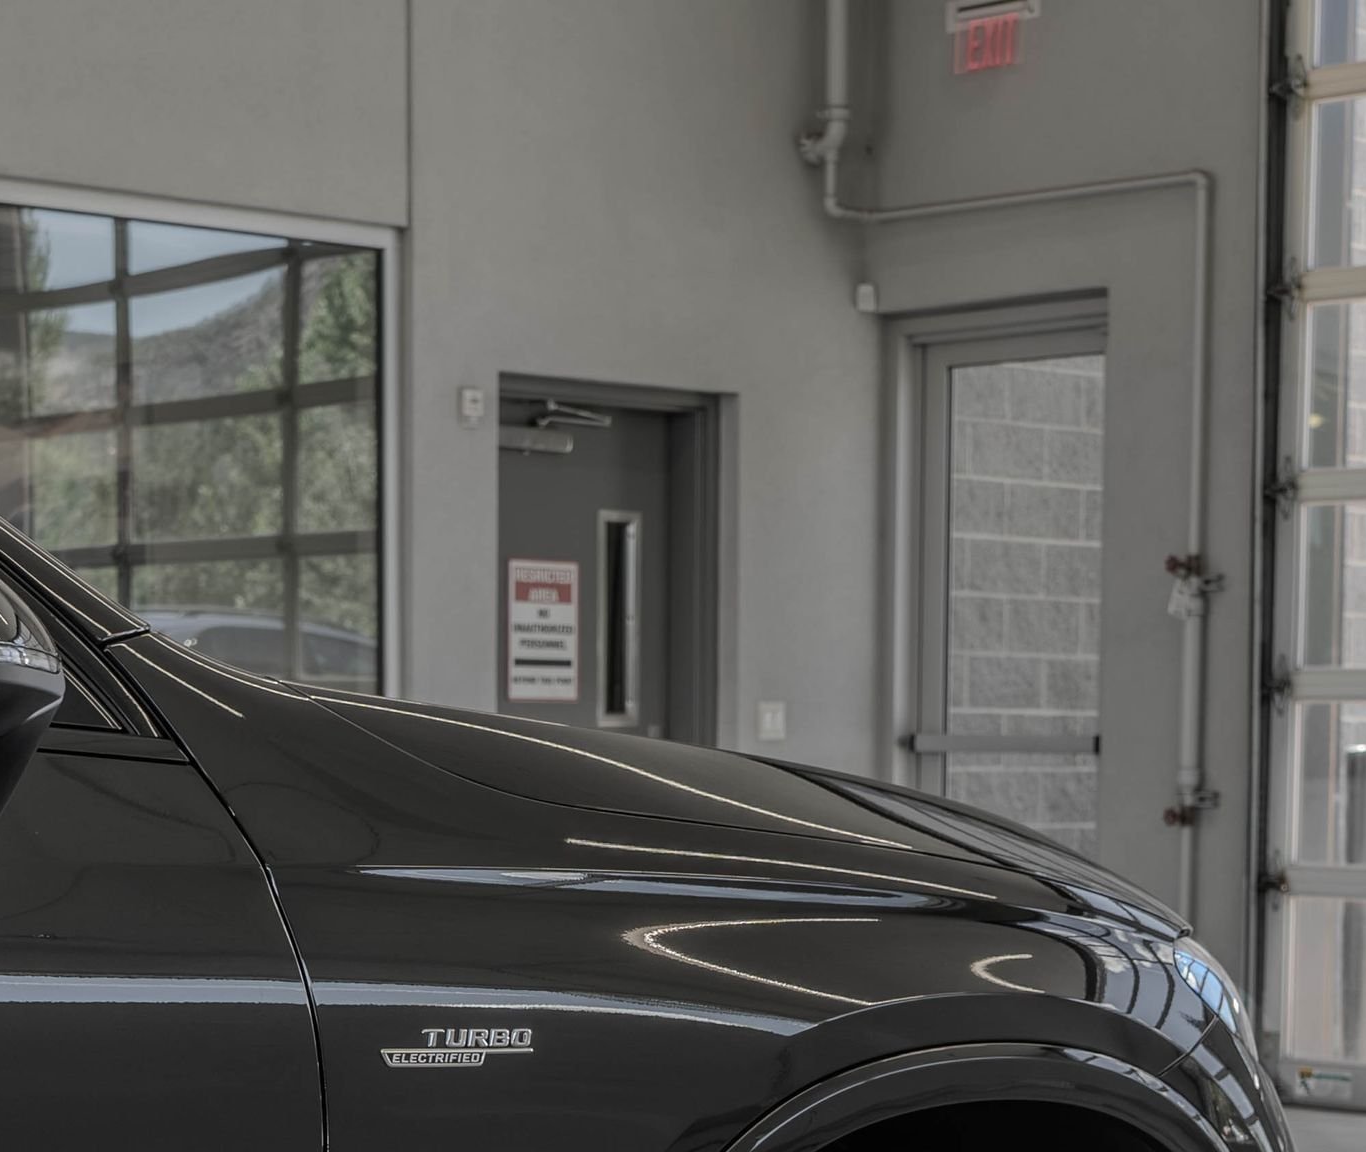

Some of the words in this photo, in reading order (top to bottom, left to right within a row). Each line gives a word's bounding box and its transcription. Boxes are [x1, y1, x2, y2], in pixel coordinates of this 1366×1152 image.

[967, 12, 1019, 71] EXIT
[421, 1028, 533, 1048] TURBO
[391, 1053, 481, 1064] ELECTRIFIED
